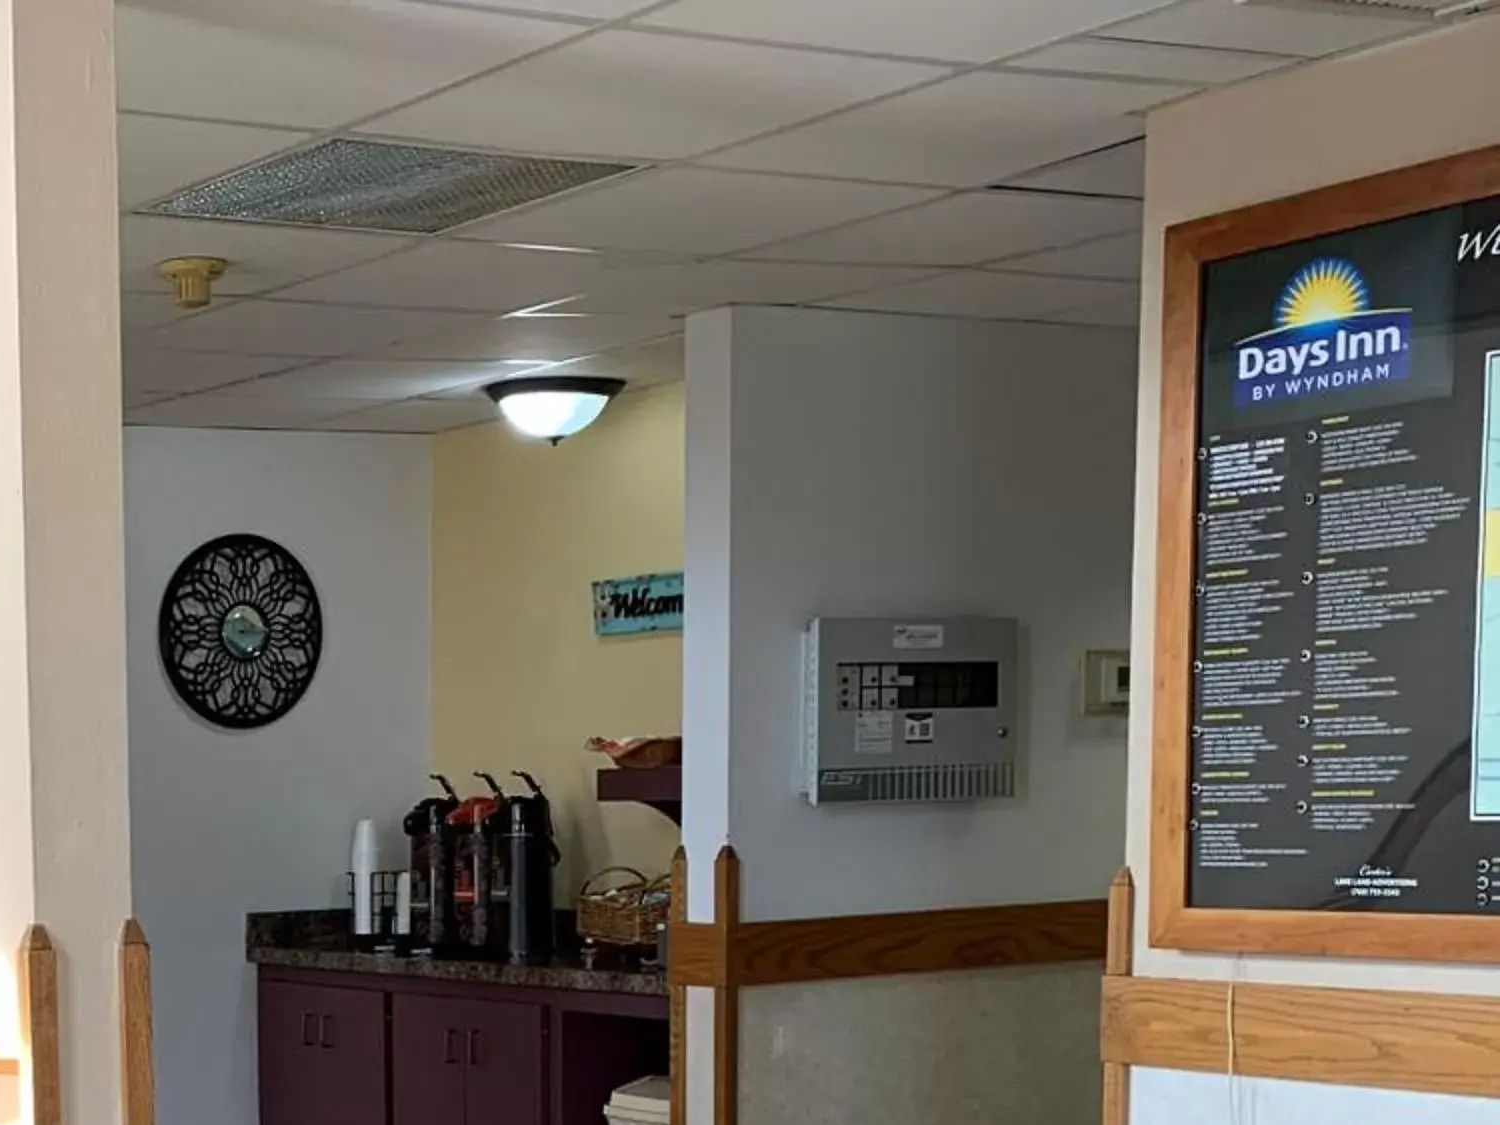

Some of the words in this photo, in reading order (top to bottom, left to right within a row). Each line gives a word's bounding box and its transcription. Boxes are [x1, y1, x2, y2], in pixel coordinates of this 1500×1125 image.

[1238, 338, 1329, 380] Days
[1336, 325, 1400, 362] Inn
[1252, 382, 1276, 401] BY
[1285, 364, 1391, 395] WYNDHAM
